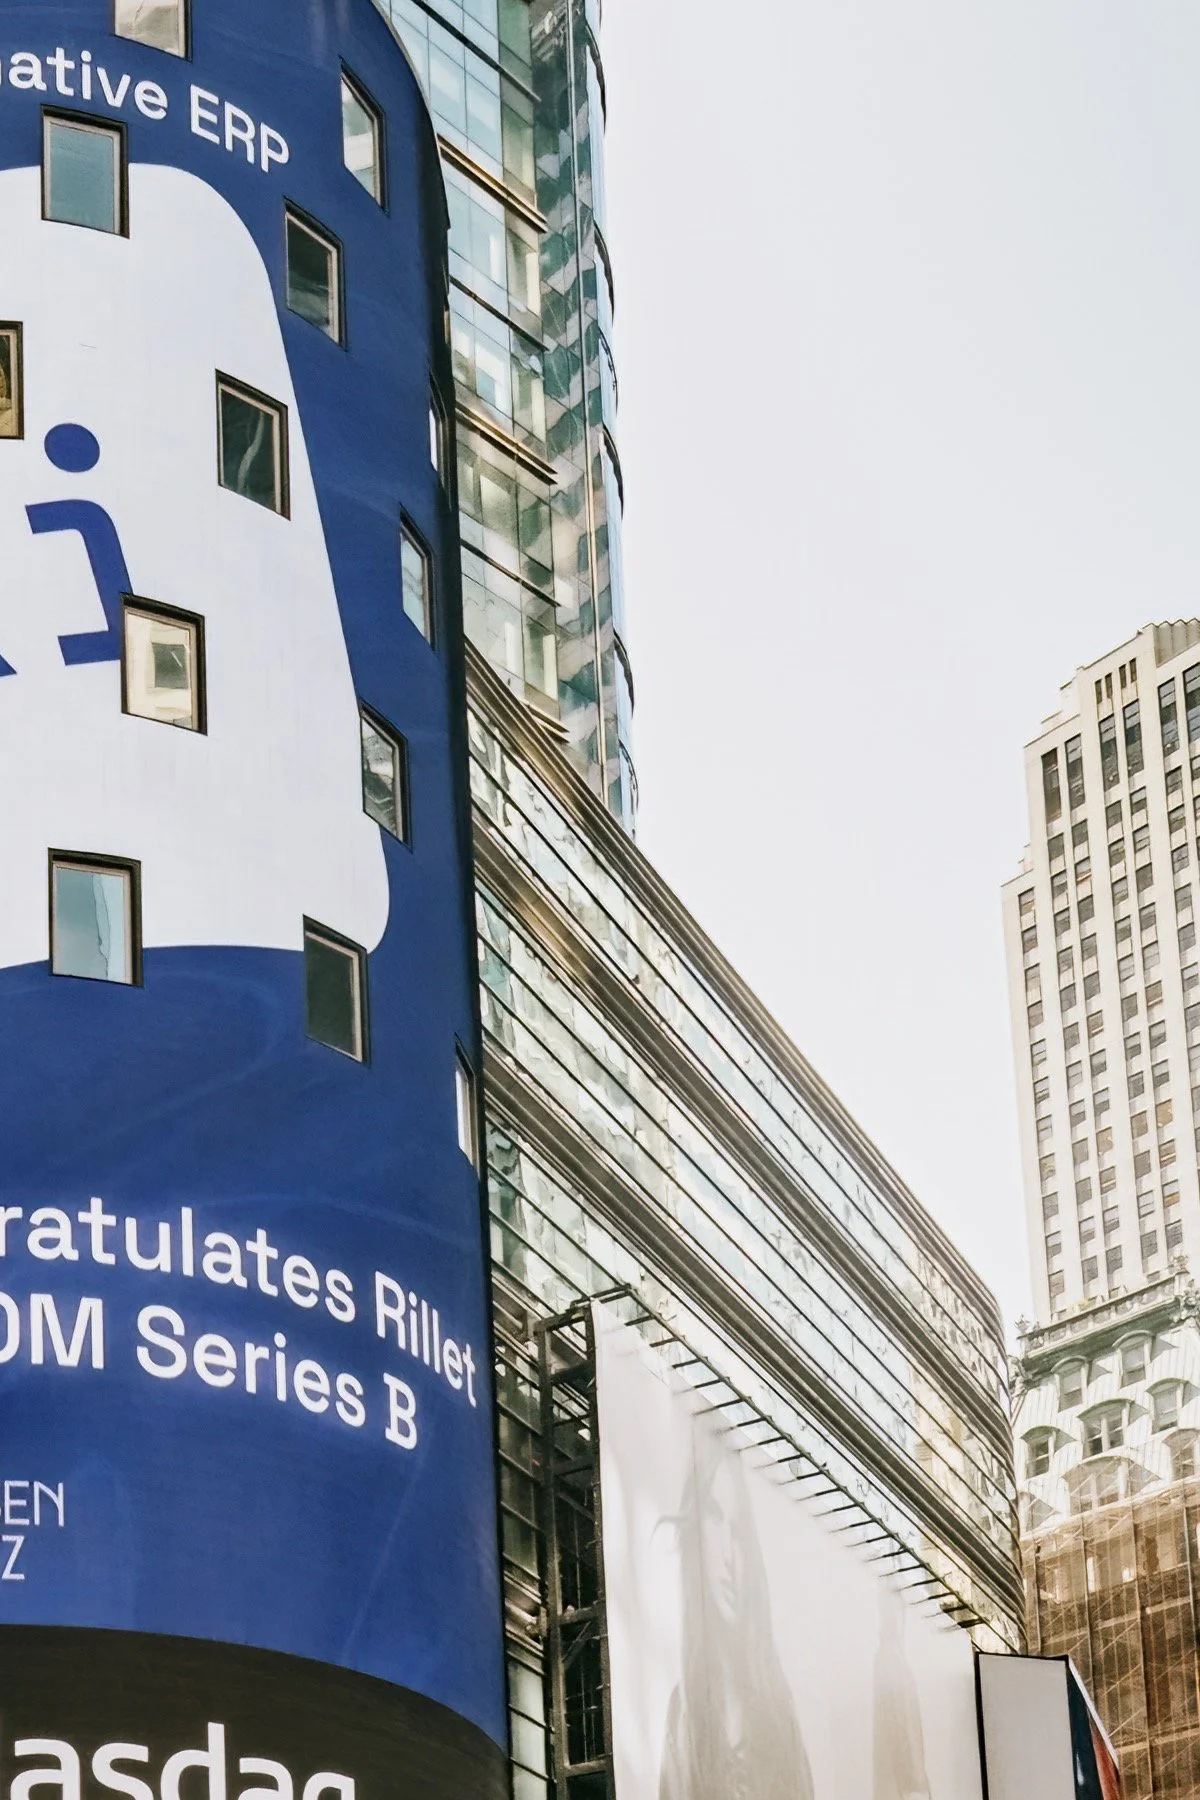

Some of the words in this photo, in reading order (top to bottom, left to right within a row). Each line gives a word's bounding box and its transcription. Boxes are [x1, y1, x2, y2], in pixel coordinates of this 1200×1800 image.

[188, 84, 290, 173] ERP
[136, 1304, 367, 1428] Series
[382, 1371, 418, 1450] B
[374, 1270, 477, 1408] Rillet
